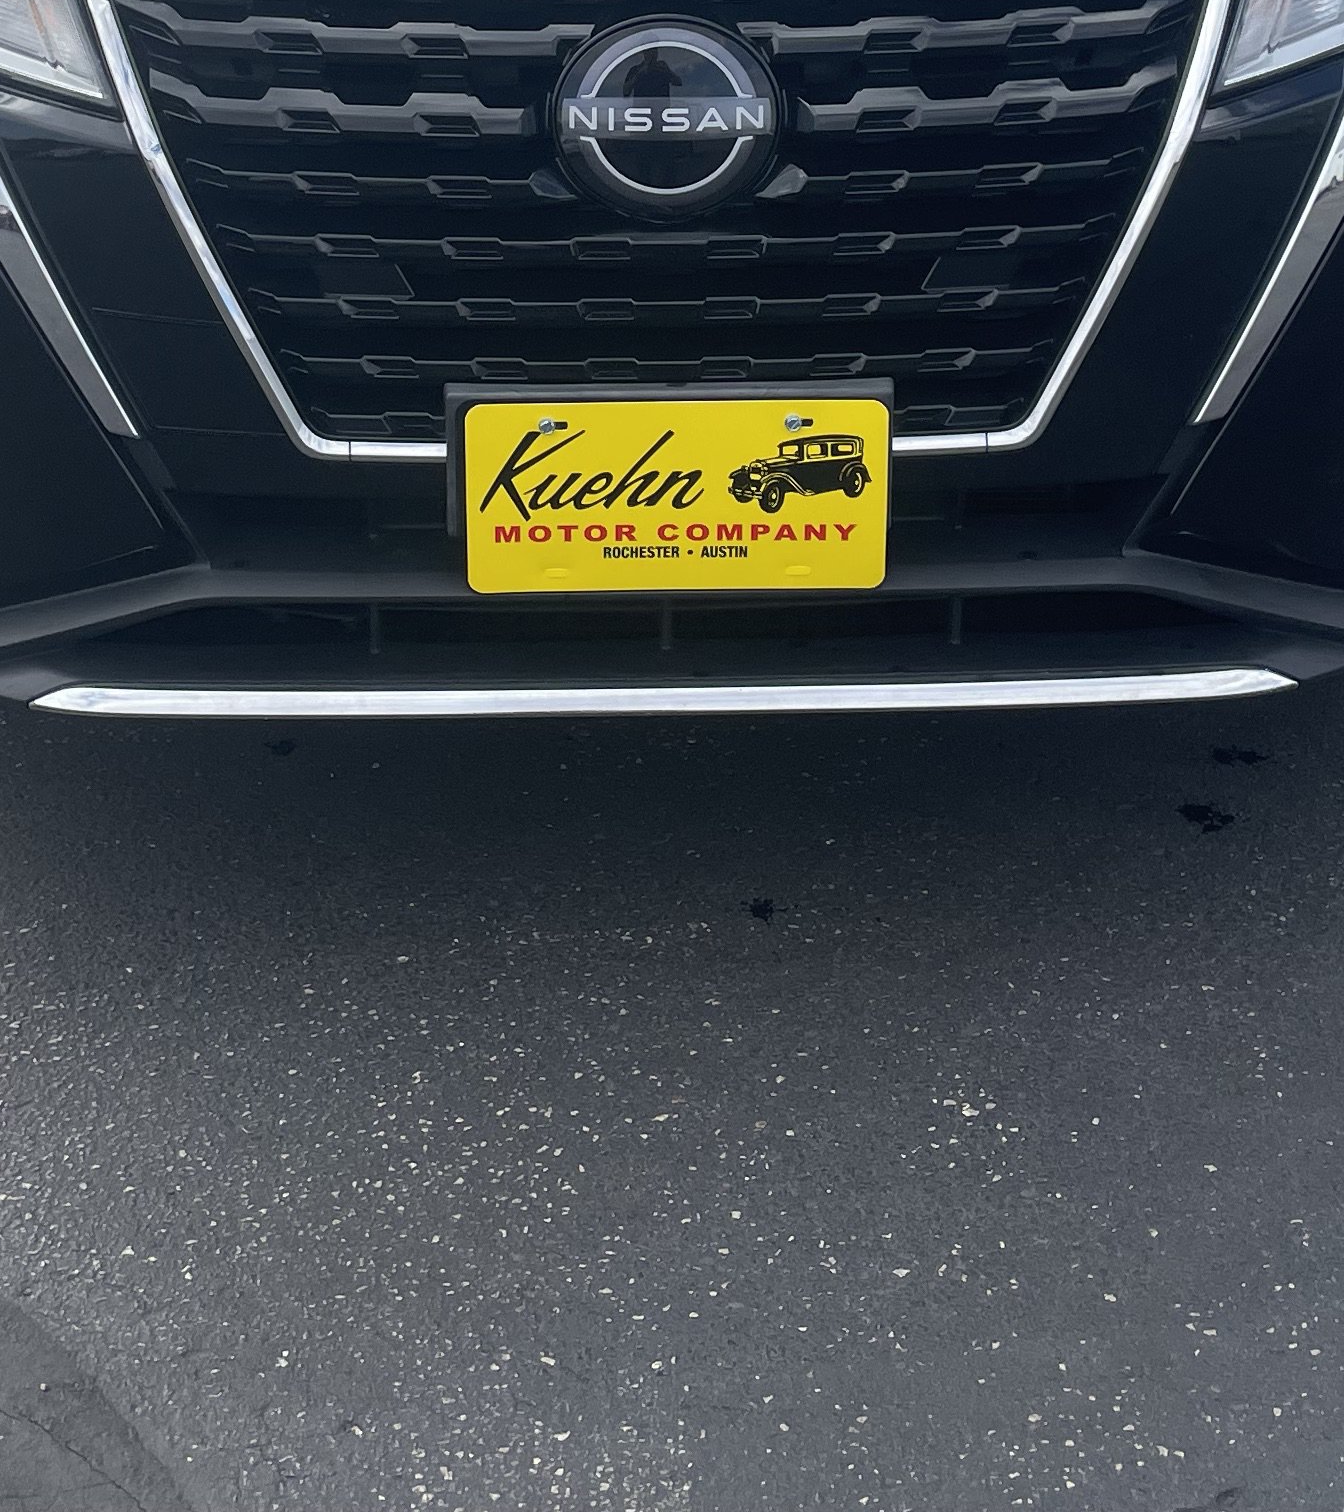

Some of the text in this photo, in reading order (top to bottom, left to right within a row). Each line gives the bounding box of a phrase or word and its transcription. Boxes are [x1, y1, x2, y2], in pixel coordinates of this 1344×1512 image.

[568, 105, 764, 133] NISSAN
[480, 429, 704, 522] Kuehn
[494, 522, 858, 544] MOTOR COMPANY
[603, 545, 748, 559] ROCHESTER AUSTIN
